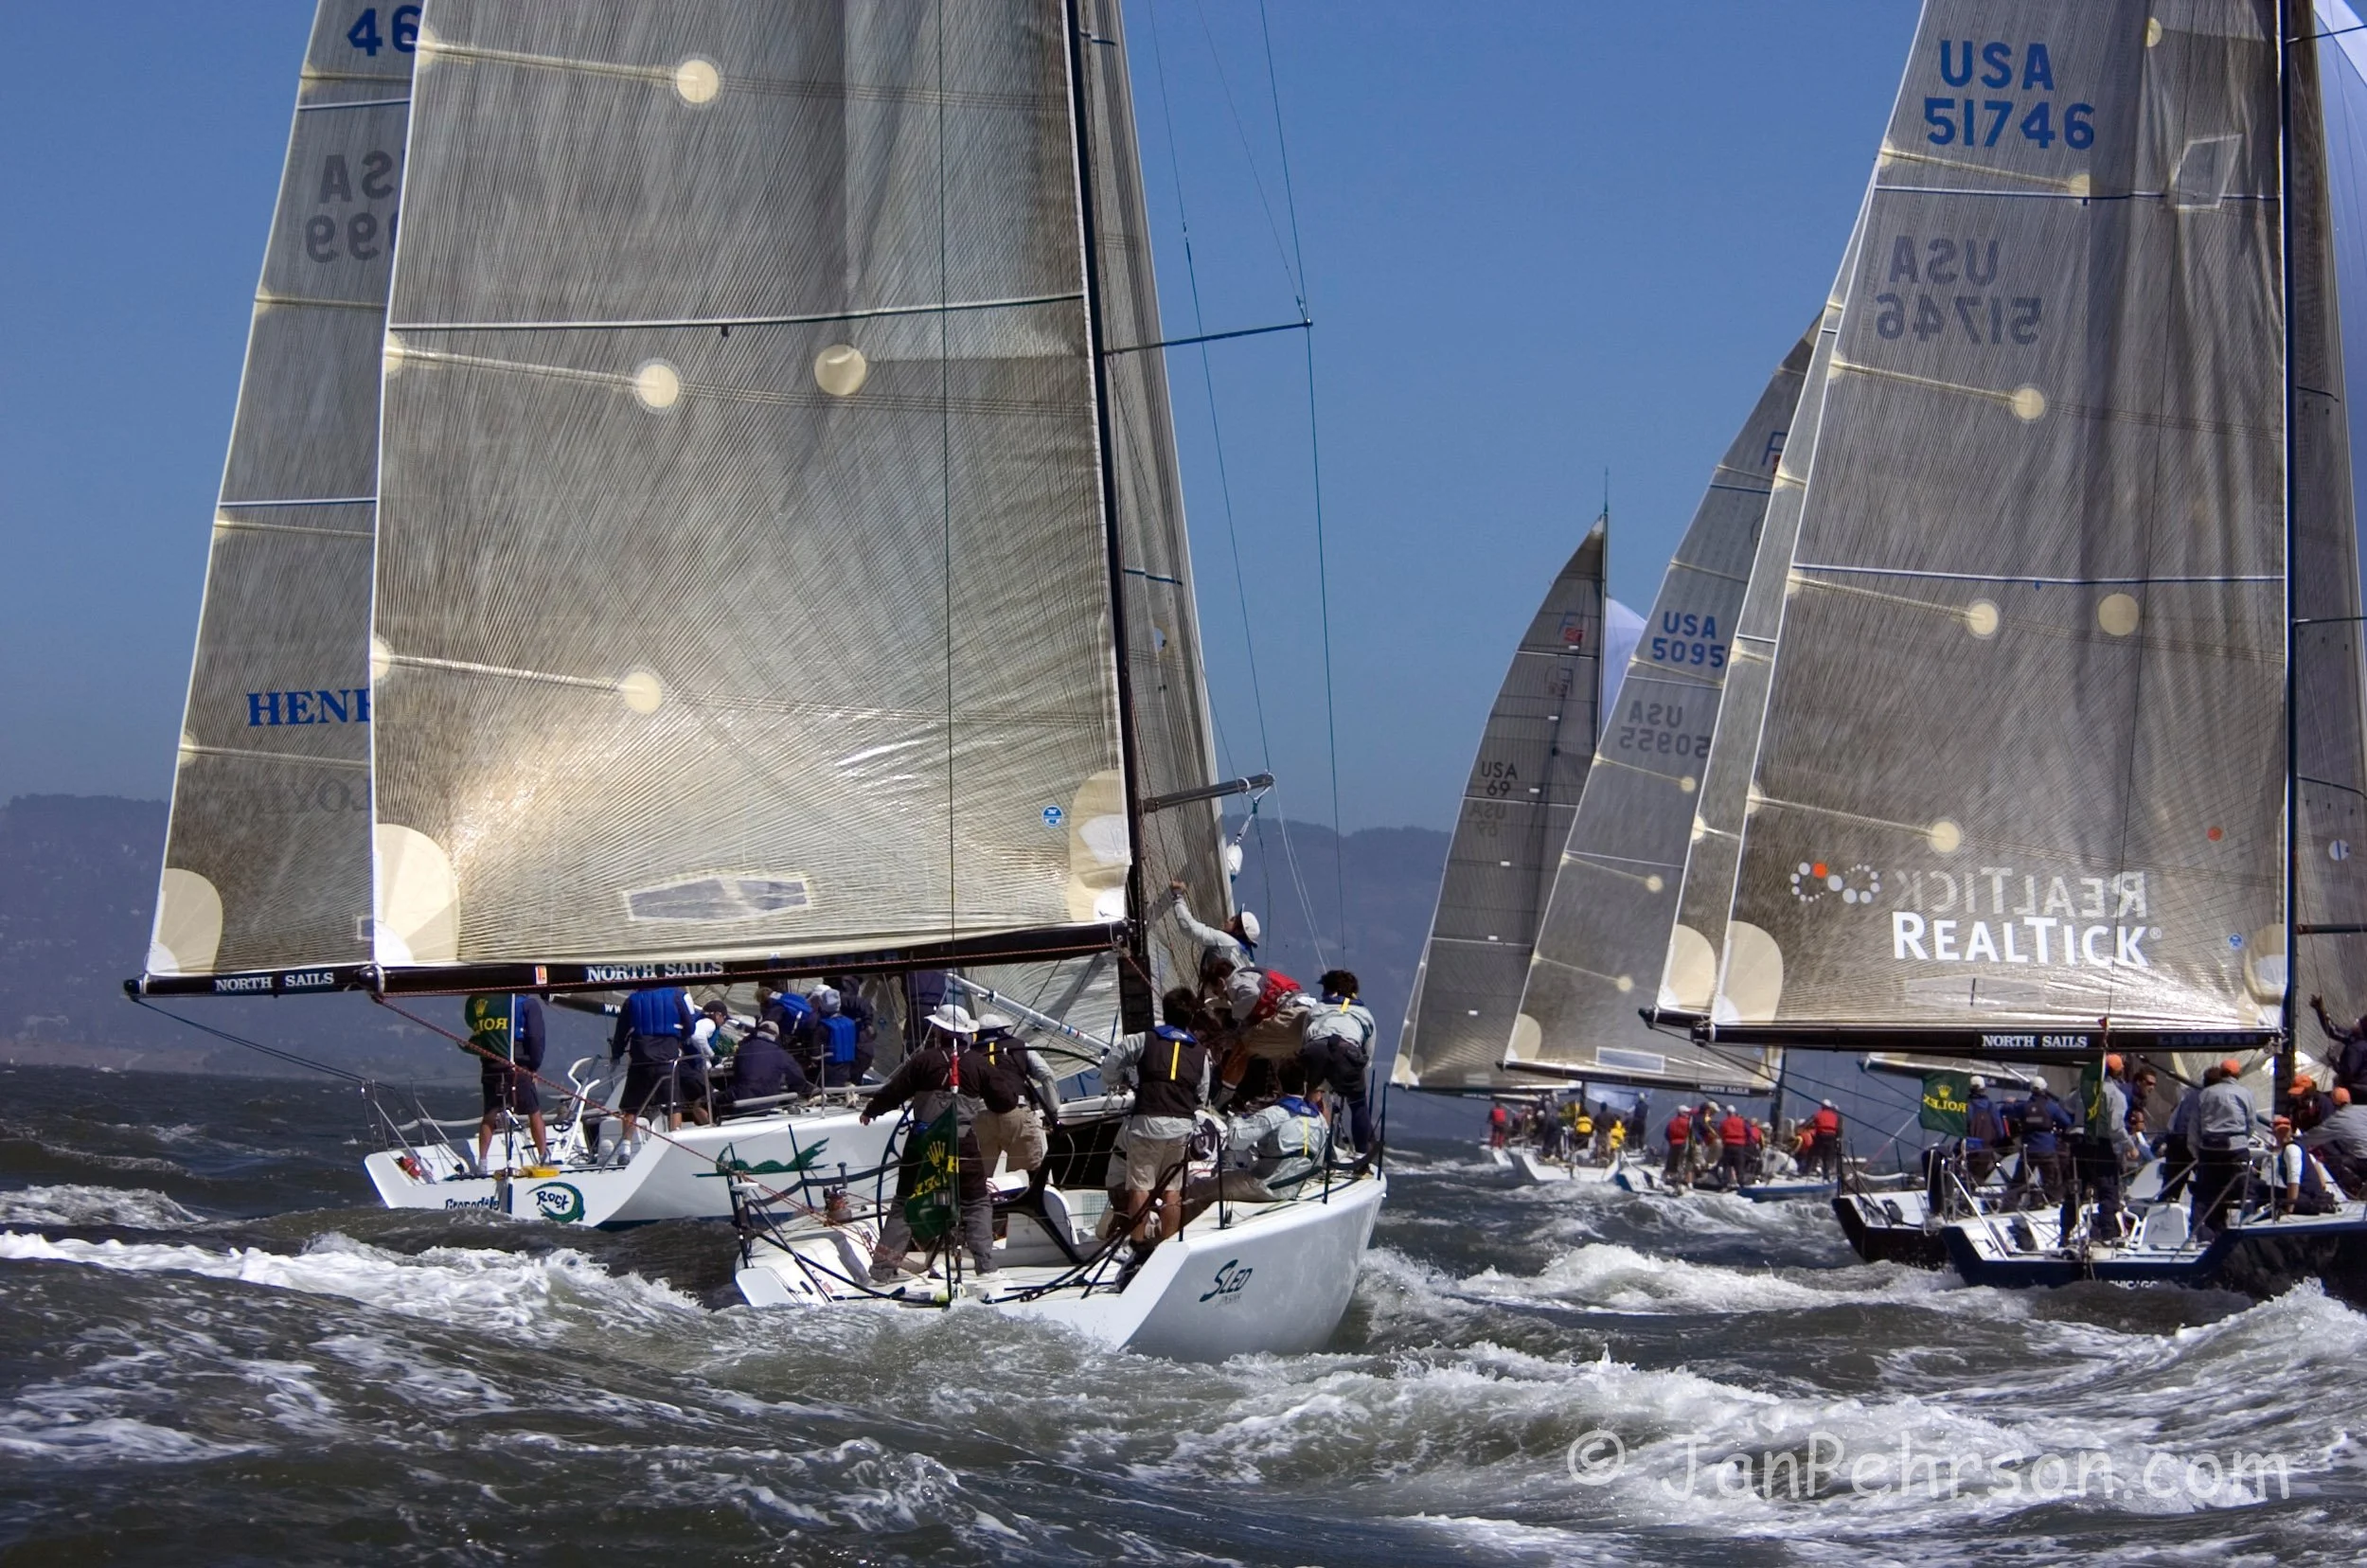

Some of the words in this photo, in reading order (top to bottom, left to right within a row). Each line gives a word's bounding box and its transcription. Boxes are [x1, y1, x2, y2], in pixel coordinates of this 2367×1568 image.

[1941, 41, 2054, 90] USA
[1924, 98, 2094, 150] 51746
[1663, 611, 1717, 640] USA
[1651, 637, 1731, 668] 5095
[1481, 761, 1518, 780] USA
[1486, 781, 1511, 796] 69
[215, 976, 273, 992] NORTH
[285, 972, 334, 988] SAILS
[585, 964, 657, 983] NORTH
[665, 961, 724, 977] SAILS
[1983, 1035, 2035, 1047] NORTH
[2042, 1036, 2088, 1047] SAILS
